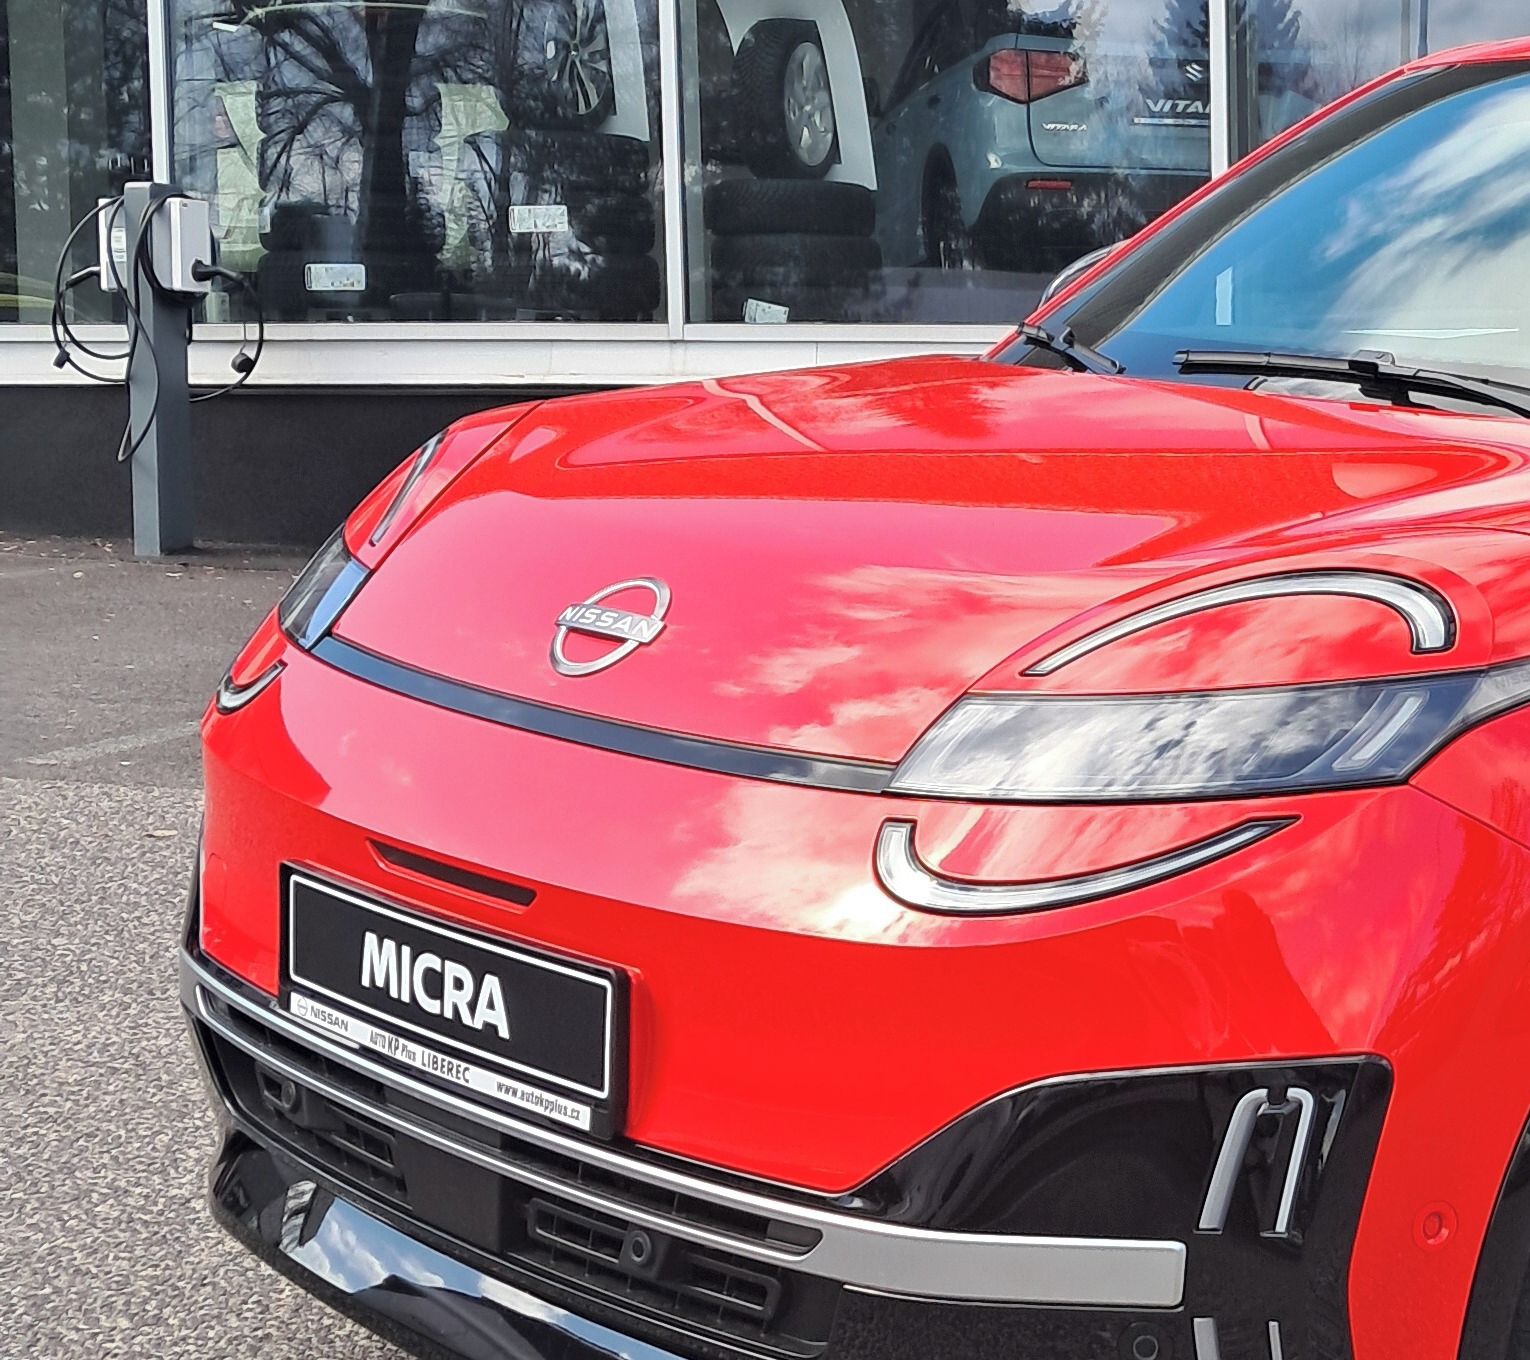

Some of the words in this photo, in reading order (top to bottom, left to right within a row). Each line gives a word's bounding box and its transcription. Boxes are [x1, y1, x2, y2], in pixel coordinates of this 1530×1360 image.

[1145, 98, 1211, 114] VITA
[558, 605, 659, 640] NISSAN
[361, 931, 510, 1040] MICRA
[310, 1005, 349, 1033] NISSAN
[387, 1034, 400, 1056] KP
[421, 1050, 471, 1084] LIBEREC
